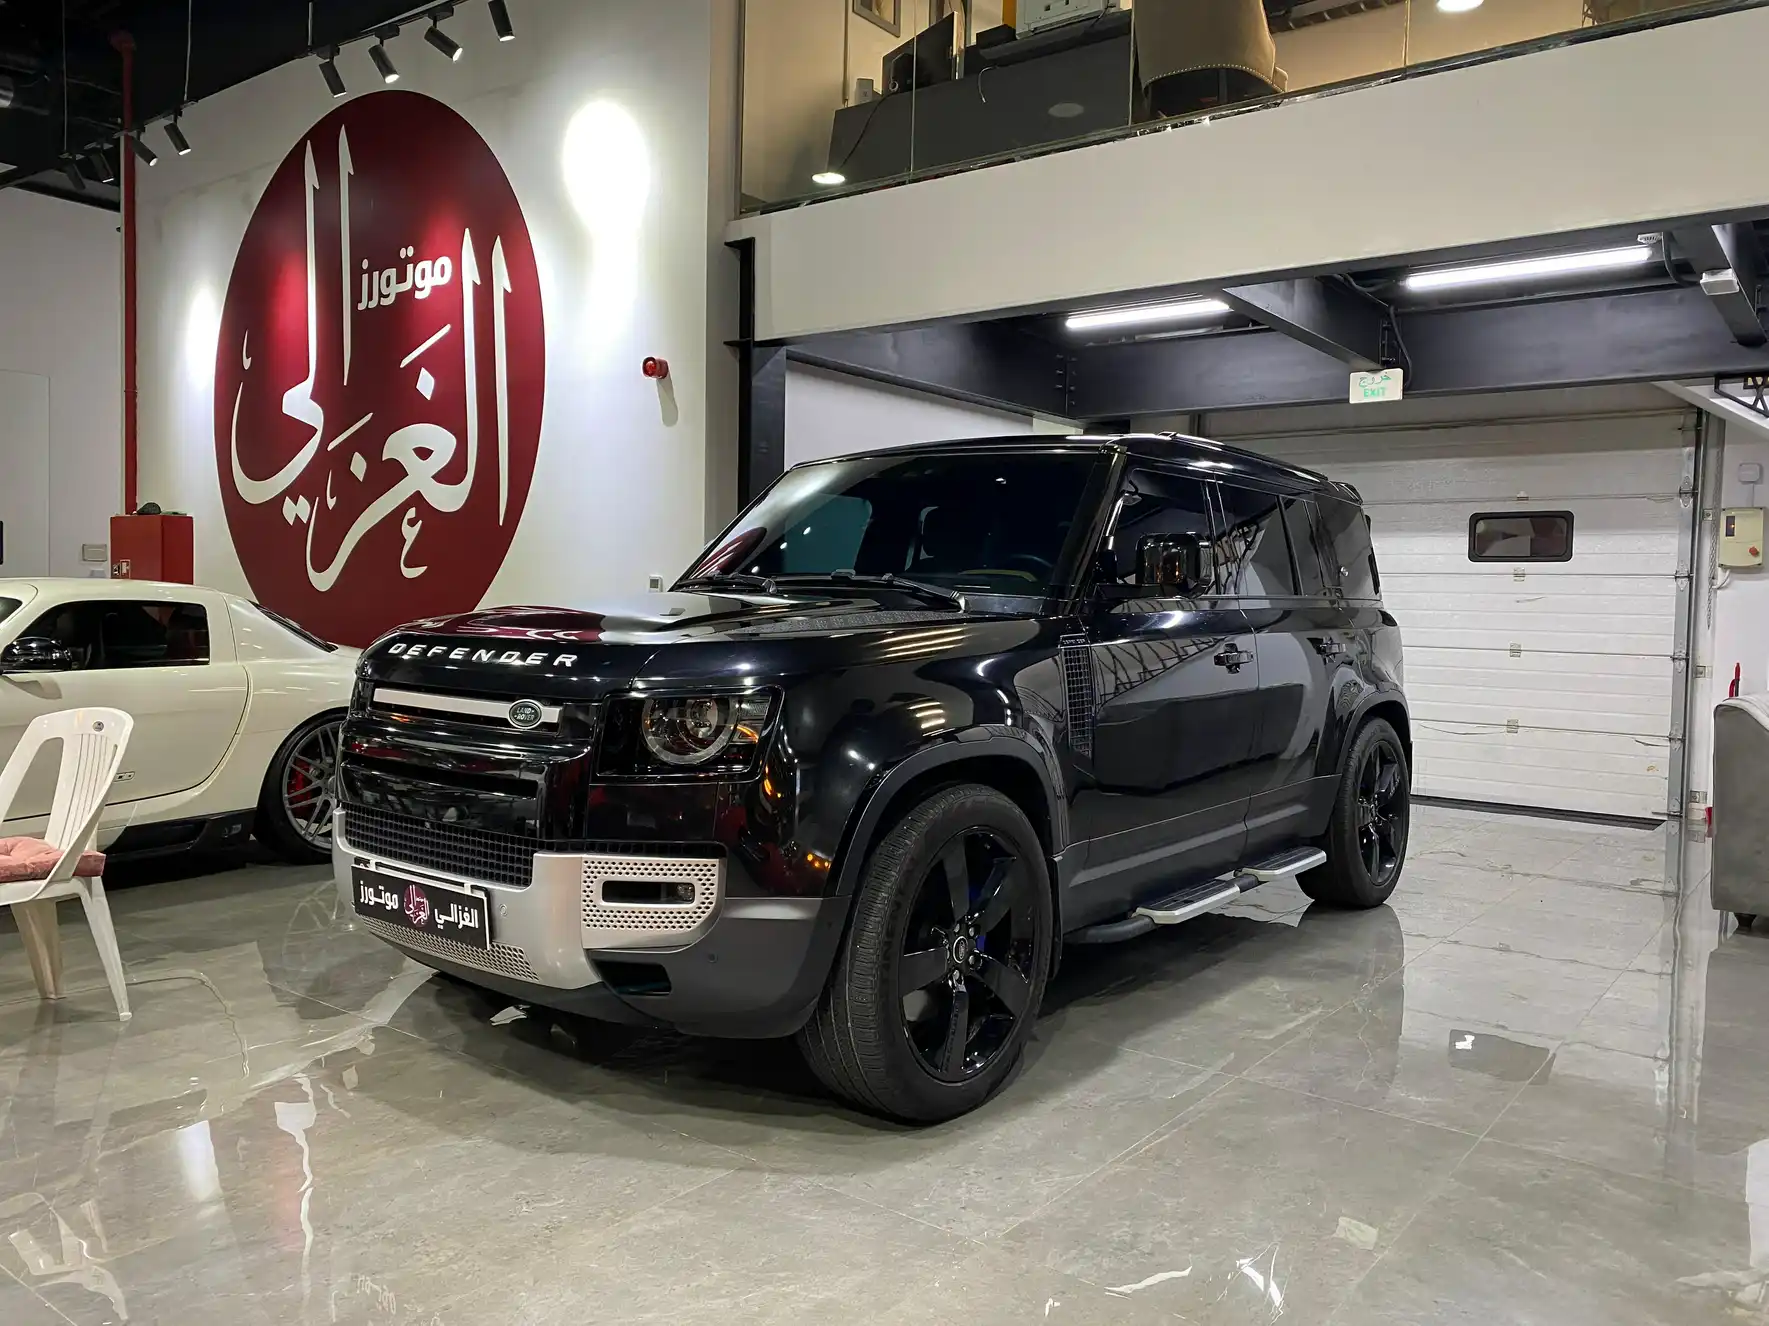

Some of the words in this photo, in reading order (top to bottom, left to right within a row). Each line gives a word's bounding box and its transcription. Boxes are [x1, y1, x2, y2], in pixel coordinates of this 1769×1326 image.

[357, 245, 453, 311] موتورز
[1363, 387, 1385, 397] EXIT
[388, 643, 578, 668] DEFENDER
[359, 880, 399, 910] موتورز
